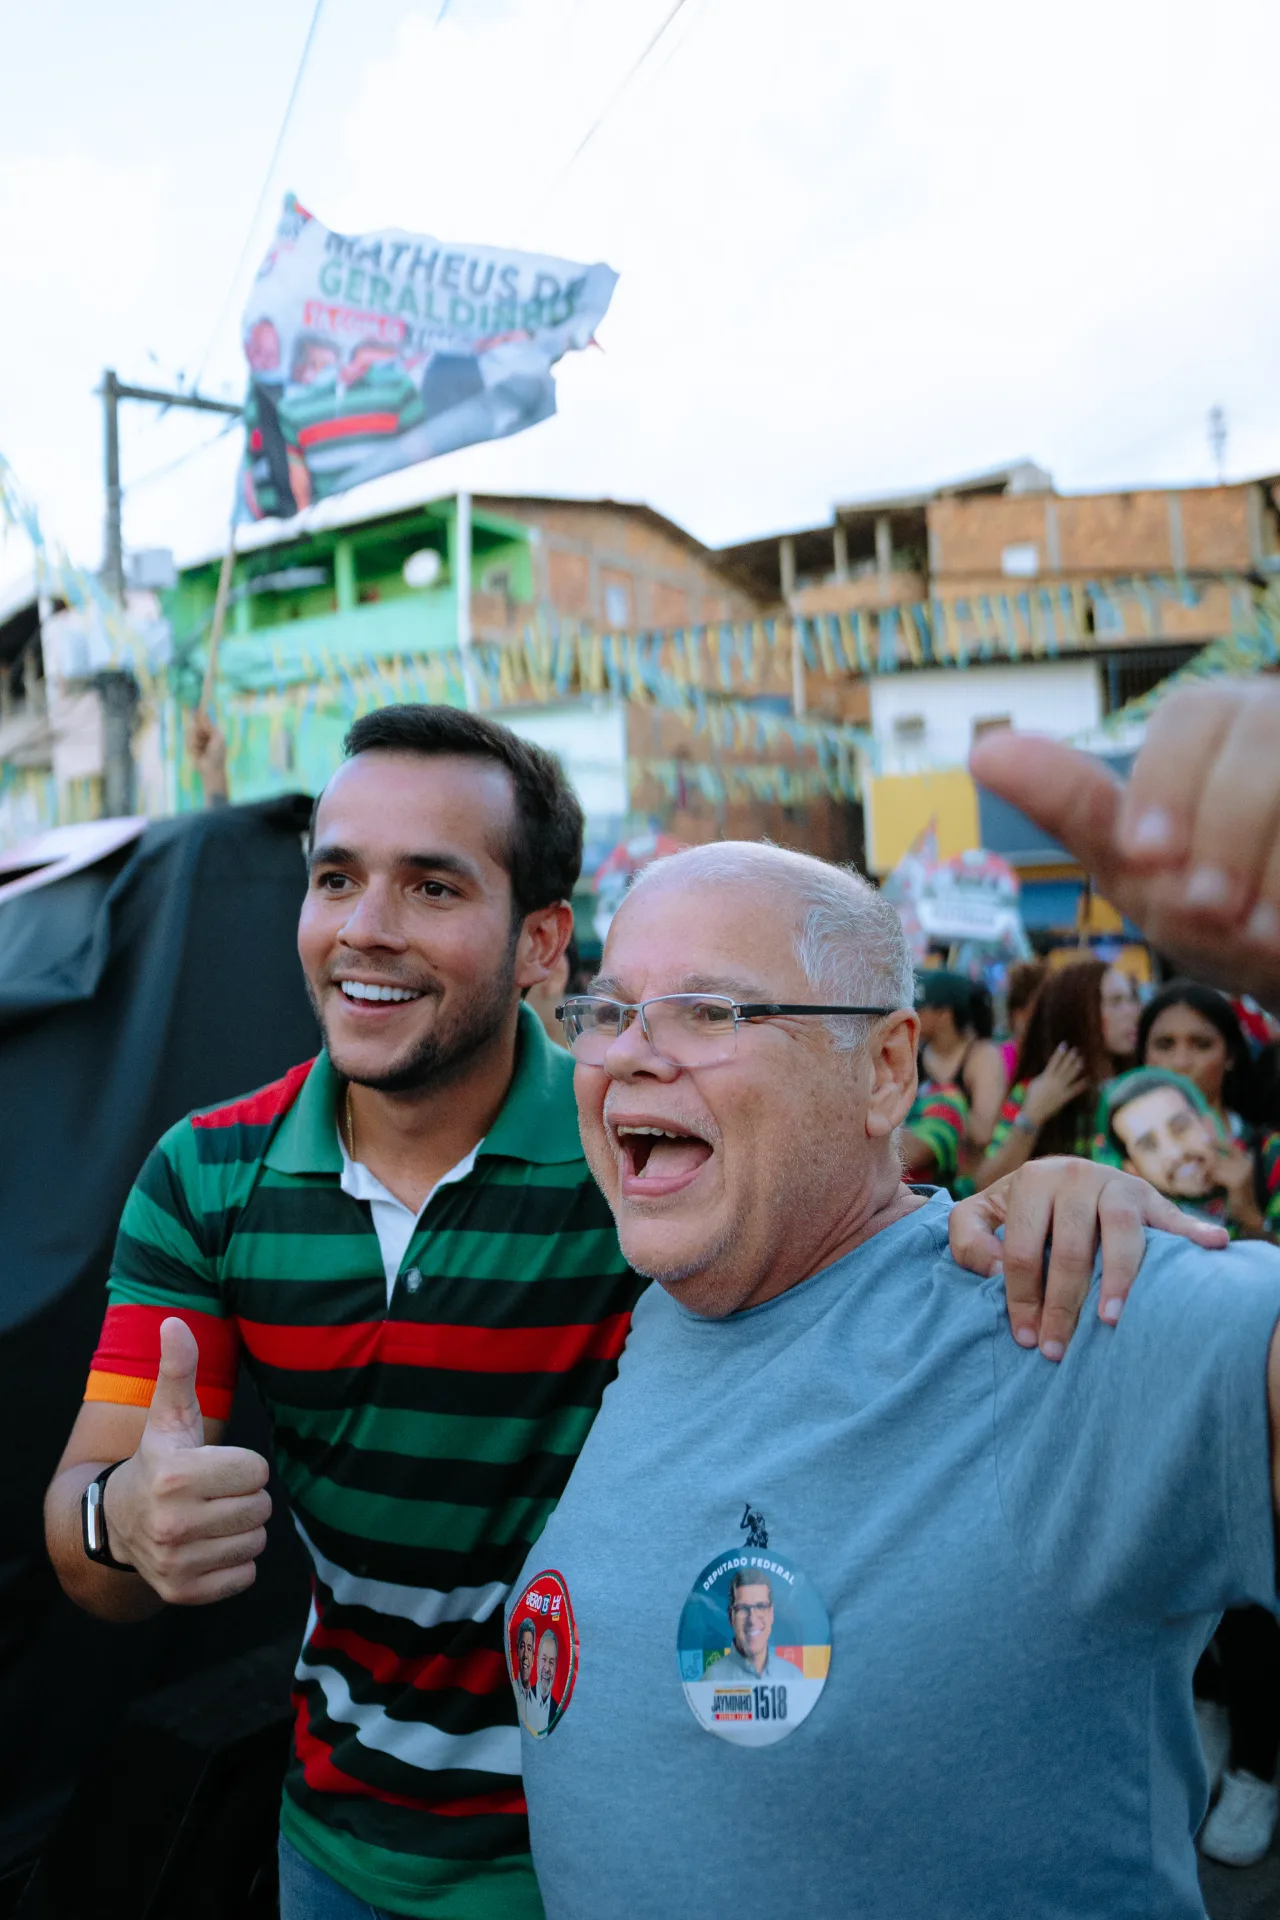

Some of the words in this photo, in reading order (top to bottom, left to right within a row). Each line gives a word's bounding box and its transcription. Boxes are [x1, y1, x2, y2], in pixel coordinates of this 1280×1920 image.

[318, 256, 574, 330] GERALDINHO
[324, 230, 520, 303] MATHEUS
[703, 1557, 748, 1591] DEPUTADO
[750, 1557, 796, 1585] FEDERAL
[711, 1694, 752, 1713] JAYMINHO
[753, 1684, 788, 1721] 1518
